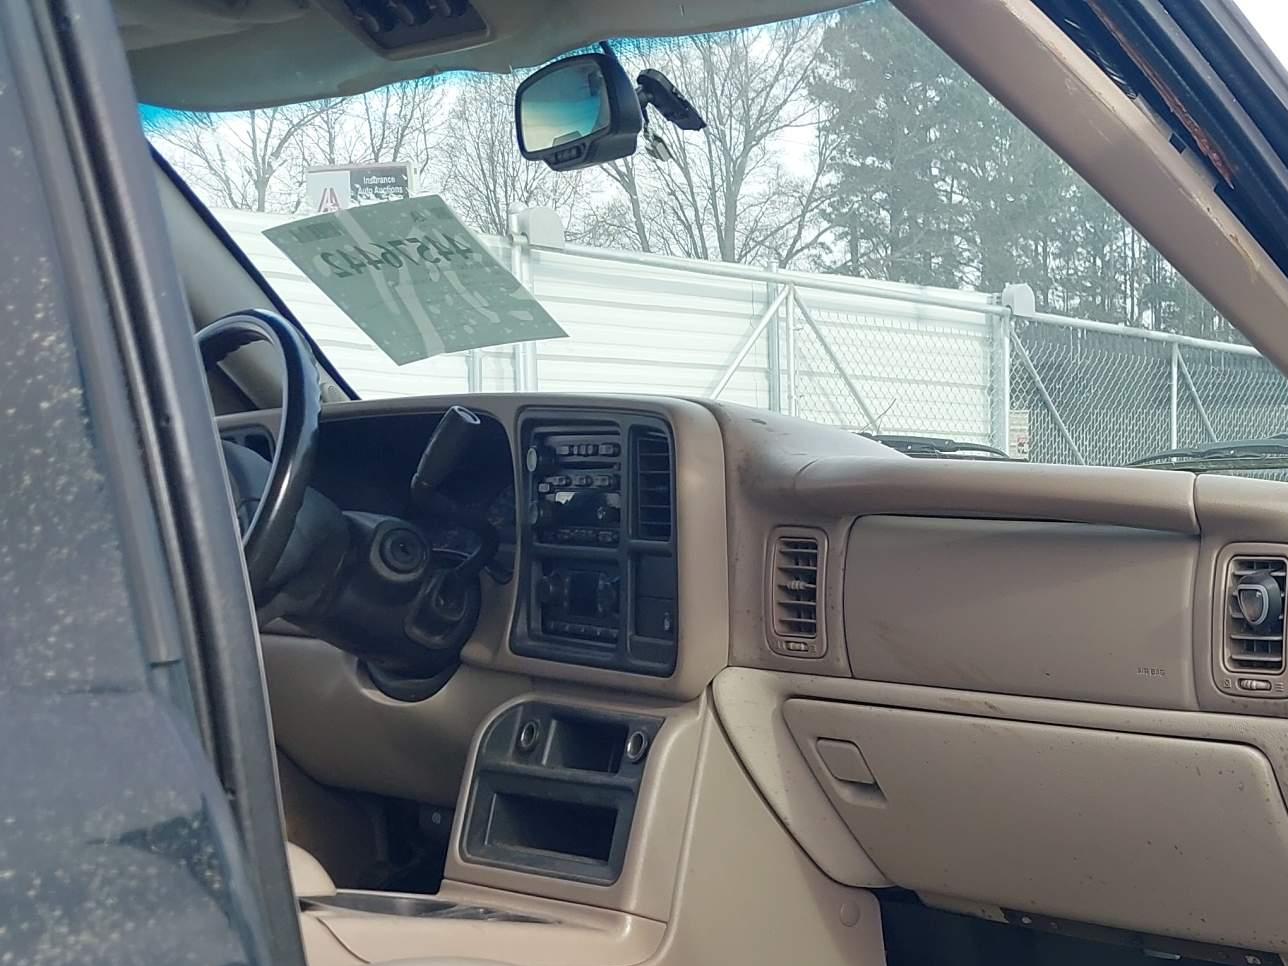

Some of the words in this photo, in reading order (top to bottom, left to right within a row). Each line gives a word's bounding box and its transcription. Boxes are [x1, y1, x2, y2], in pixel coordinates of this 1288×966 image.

[363, 175, 396, 185] Insurance
[358, 186, 372, 194] Auto
[374, 185, 403, 194] Auctions
